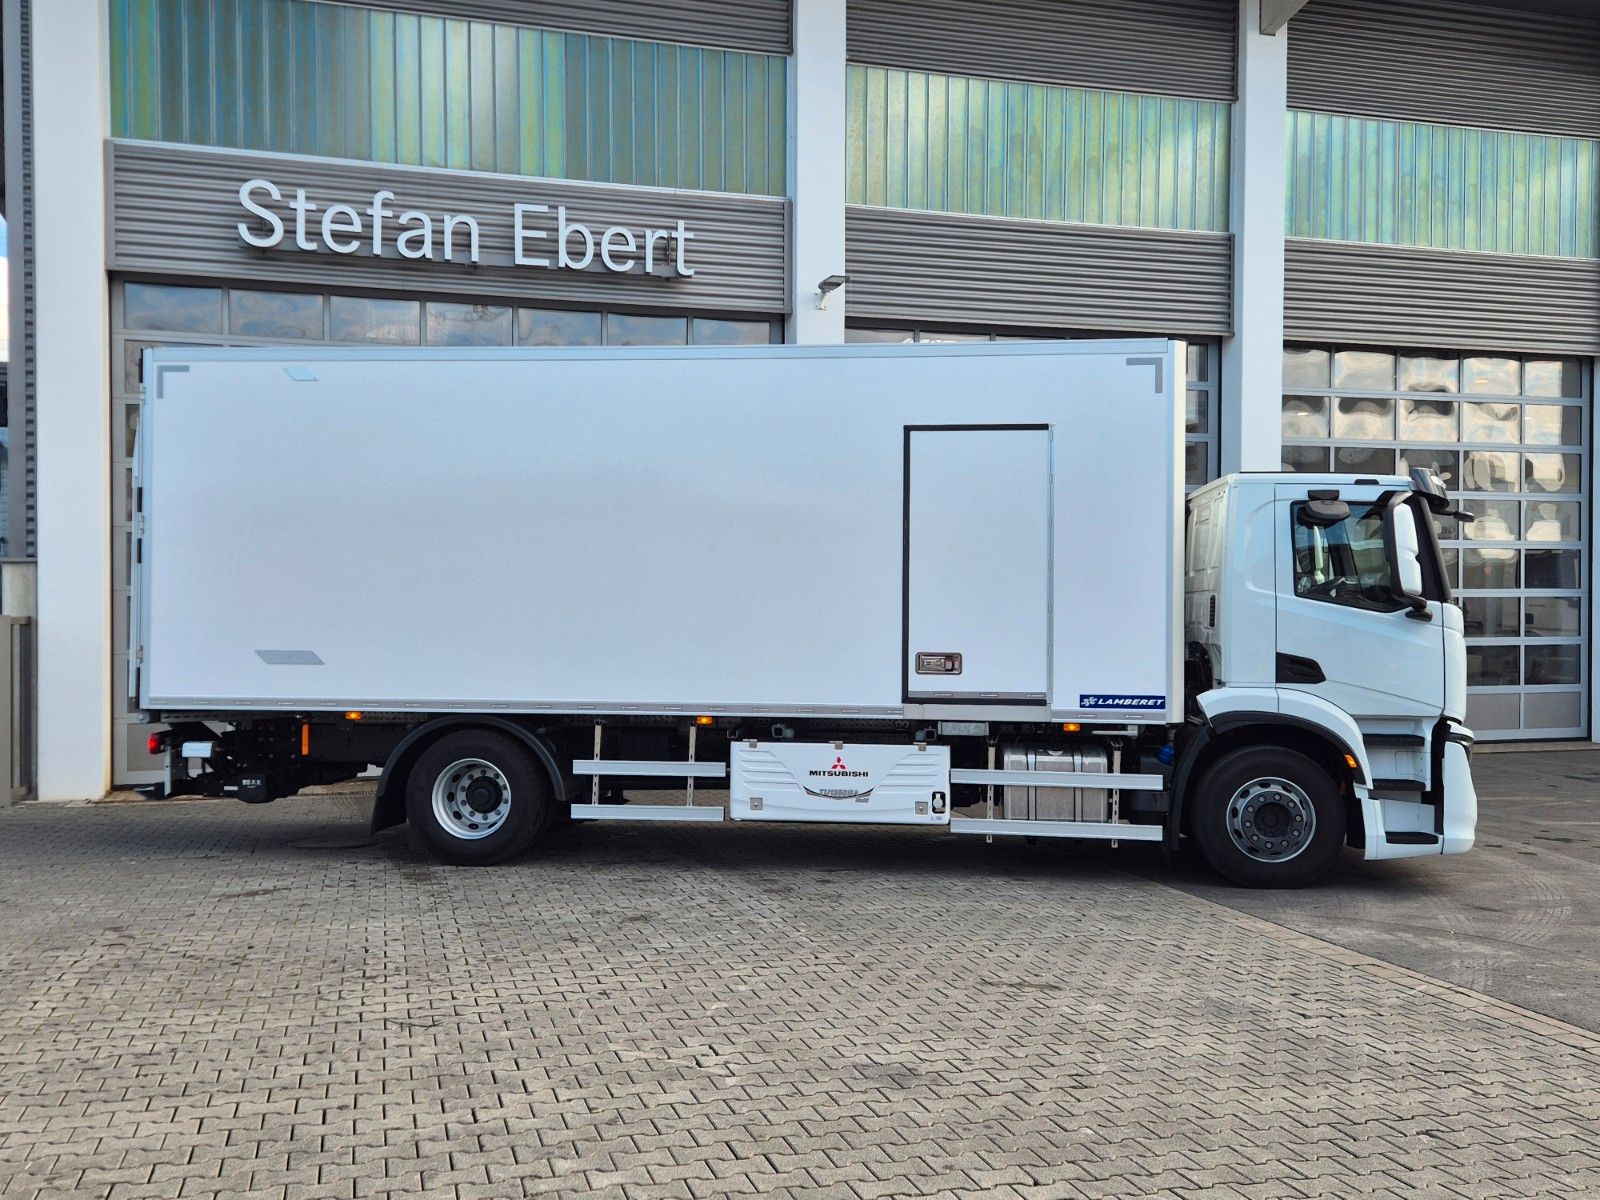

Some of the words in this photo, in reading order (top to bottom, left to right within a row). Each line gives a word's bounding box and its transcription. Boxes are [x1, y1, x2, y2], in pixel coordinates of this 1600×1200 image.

[237, 179, 480, 263] Stefan
[513, 203, 696, 277] Ebert
[1097, 698, 1165, 706] LAMBERET
